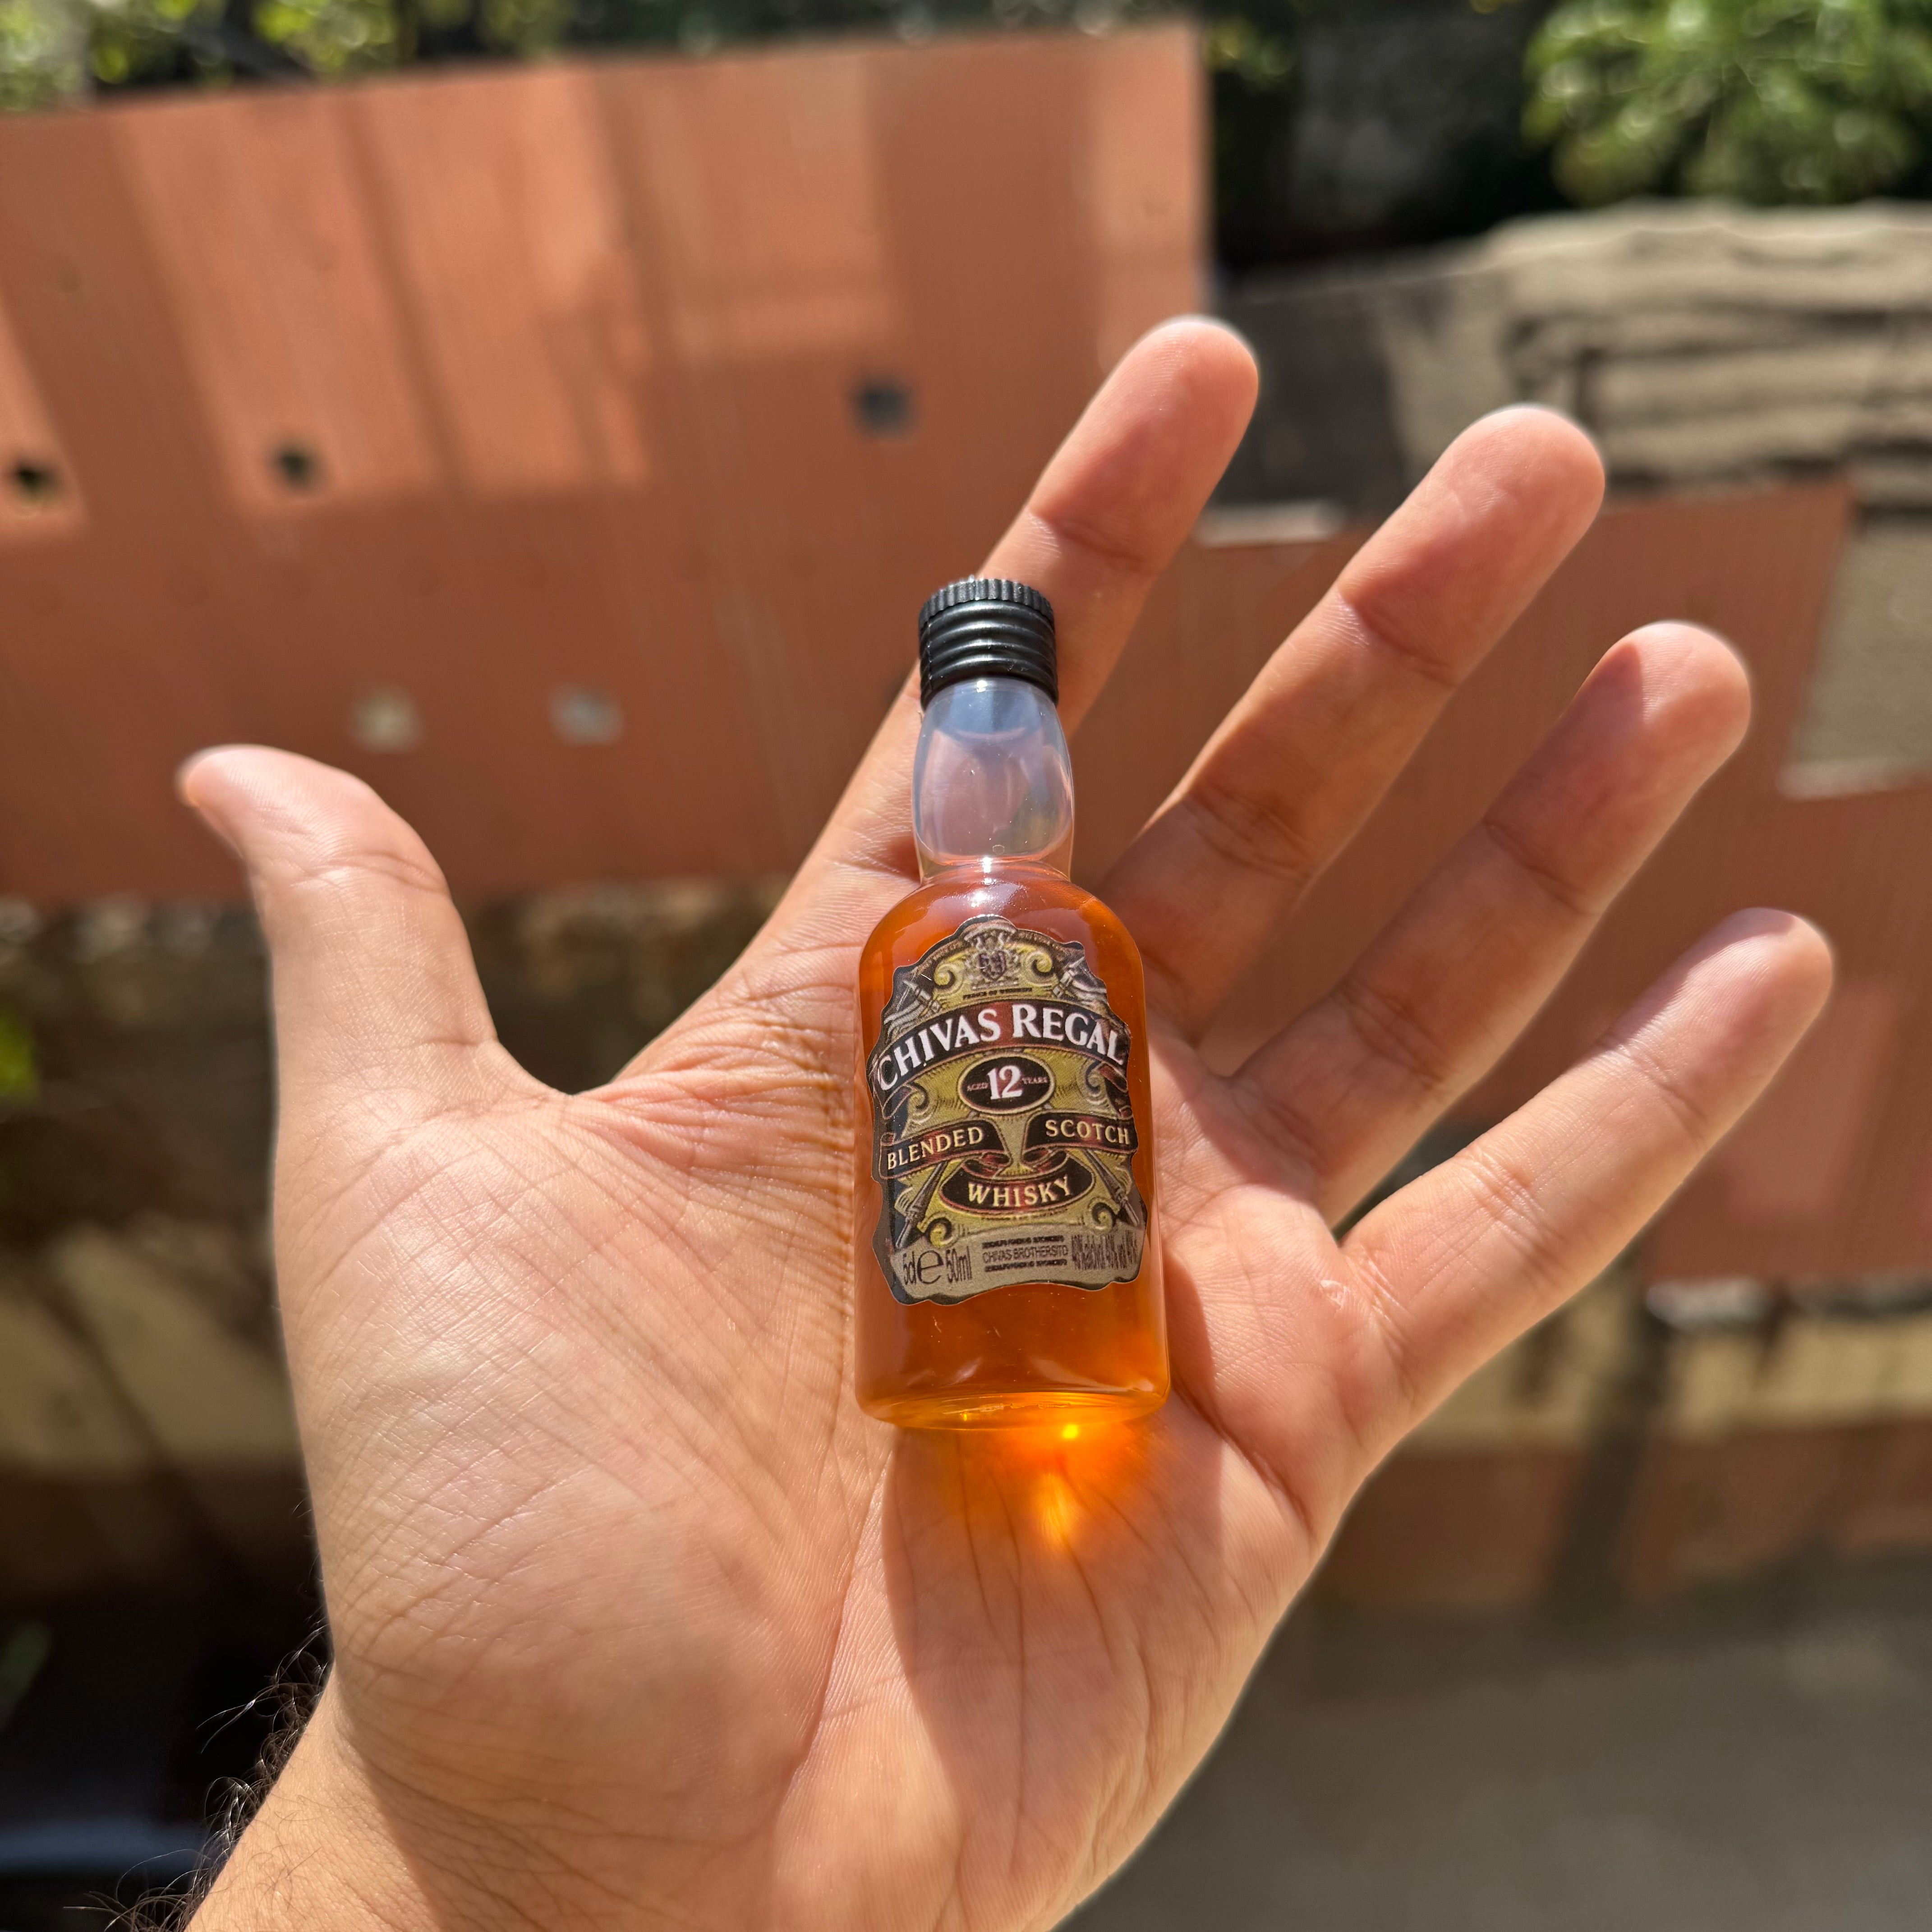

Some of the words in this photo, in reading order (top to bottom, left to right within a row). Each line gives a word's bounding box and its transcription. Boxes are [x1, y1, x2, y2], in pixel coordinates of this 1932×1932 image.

[878, 1008, 1001, 1090] CHIVAS
[1012, 1004, 1123, 1065] REGAL
[987, 1065, 1023, 1099] 12
[888, 1127, 983, 1170] BLENDED
[1045, 1119, 1130, 1145] SCOTCH
[968, 1173, 1071, 1207] WHISKY
